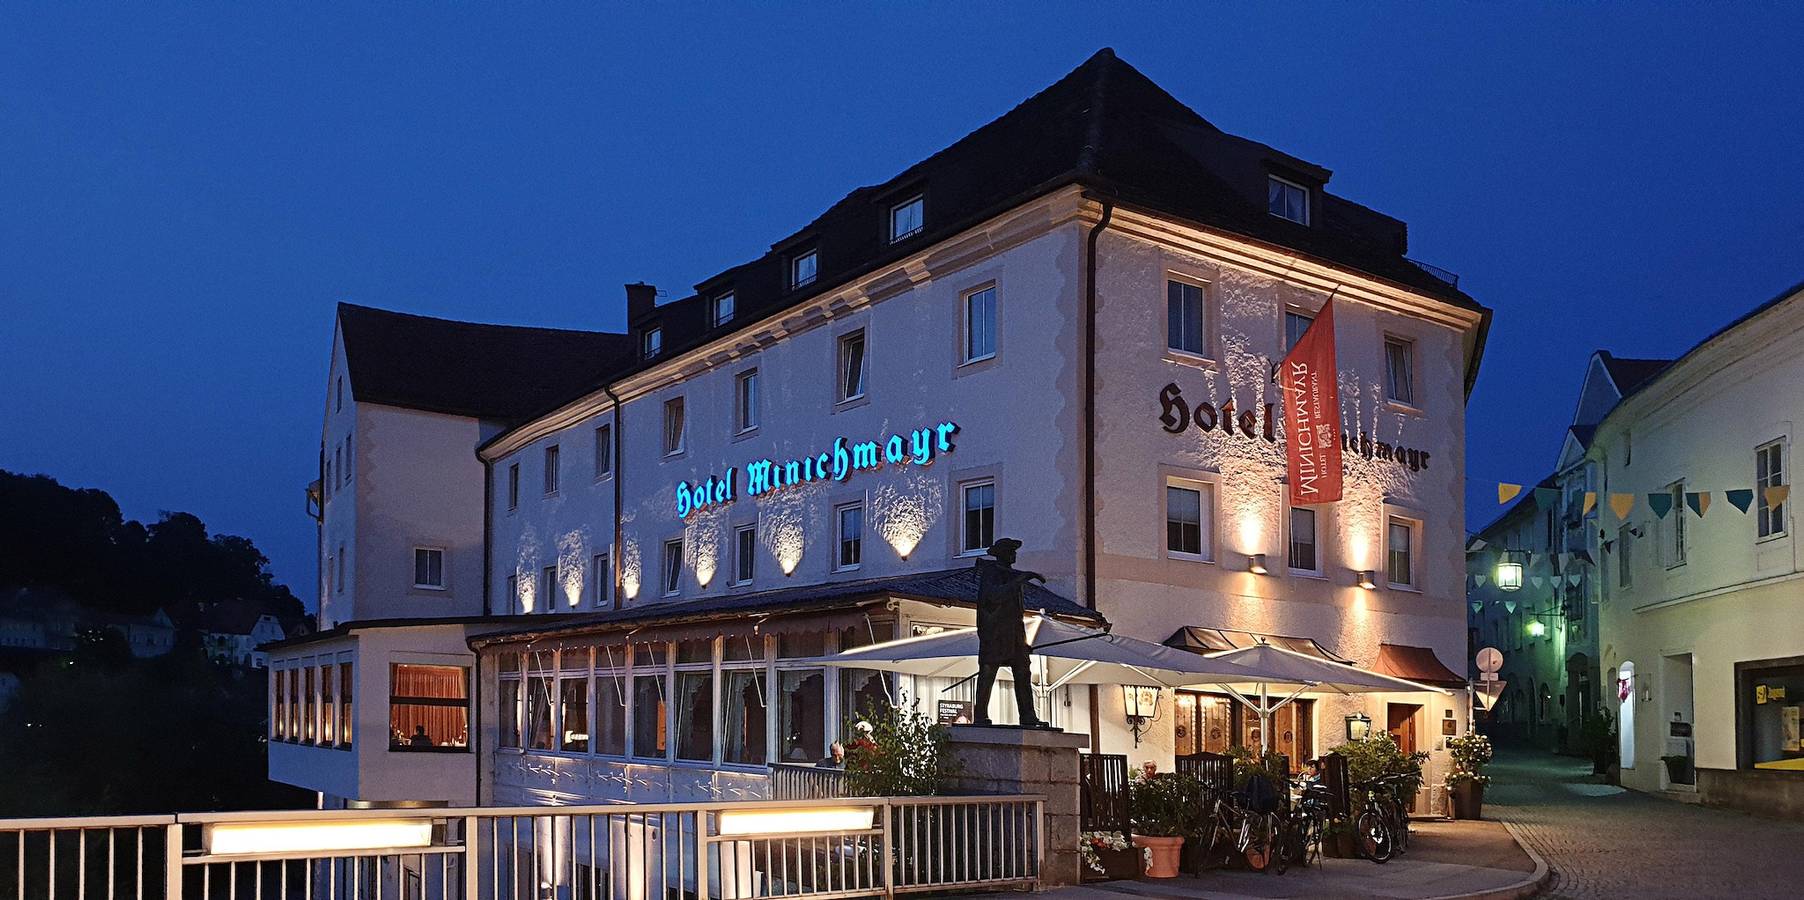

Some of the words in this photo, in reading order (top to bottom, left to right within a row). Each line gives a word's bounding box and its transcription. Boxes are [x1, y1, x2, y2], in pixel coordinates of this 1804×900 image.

[1159, 382, 1277, 443] Hotel
[677, 467, 737, 519] Hotel
[747, 421, 960, 497] Minichmayr
